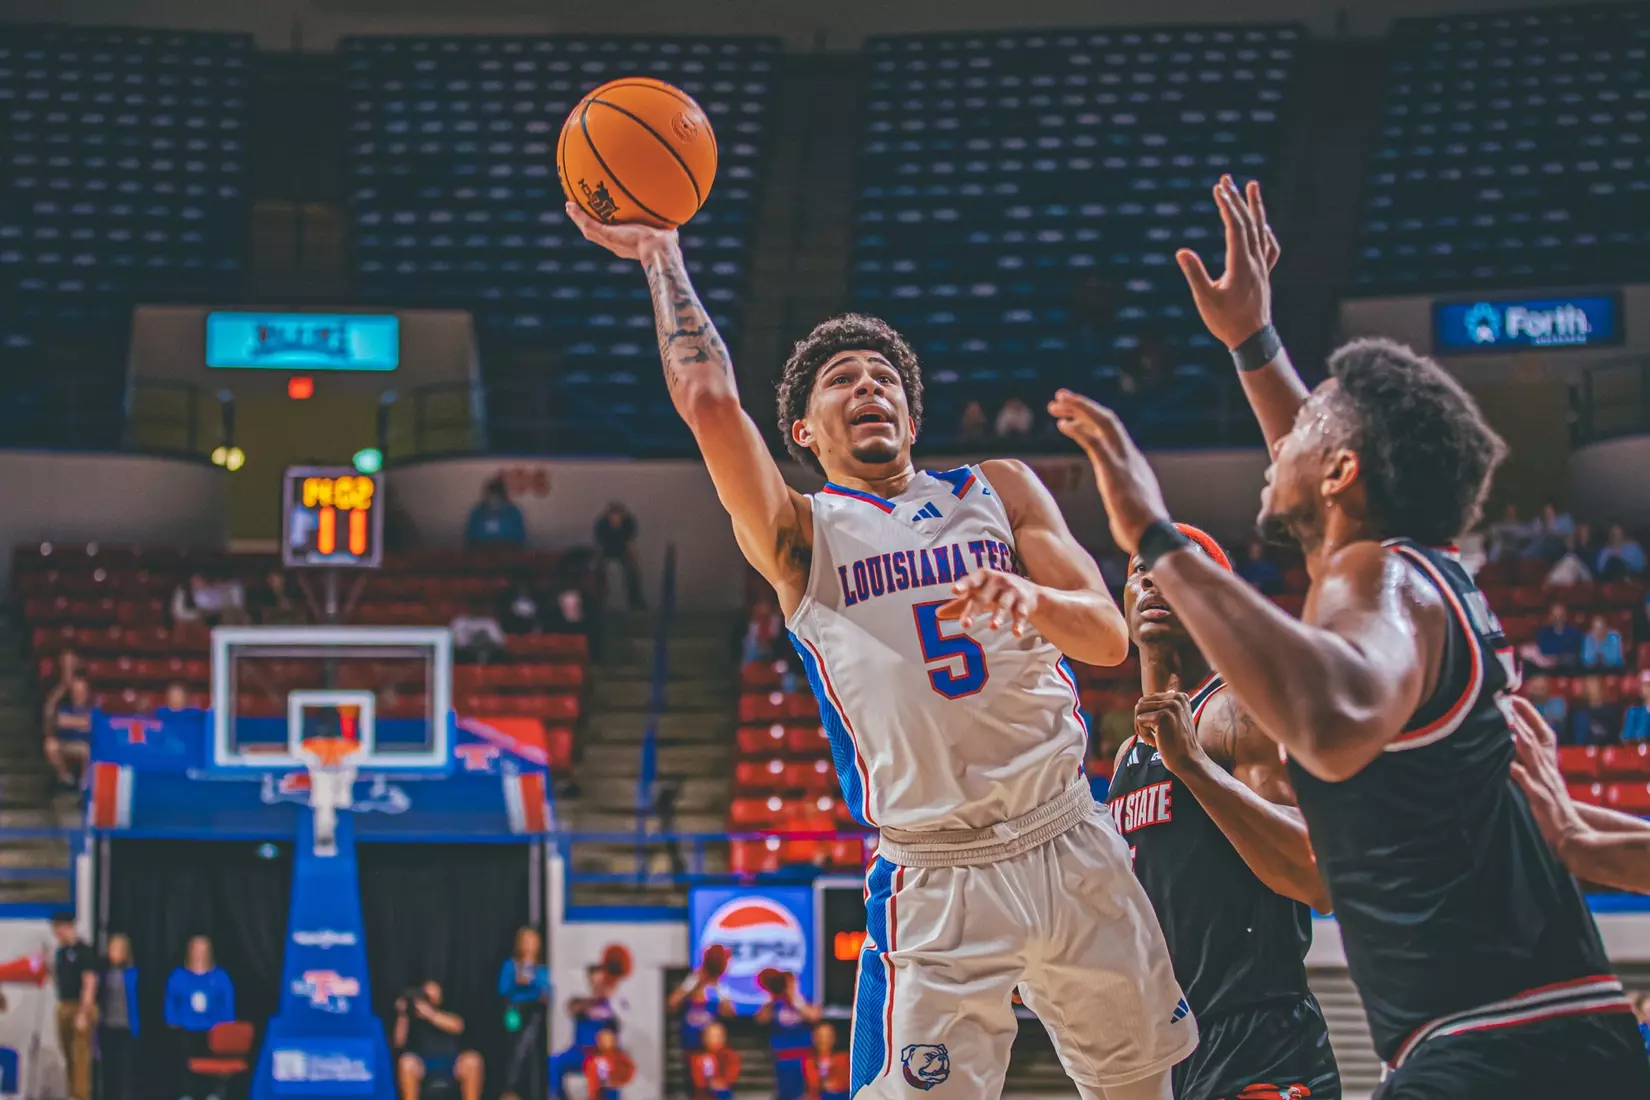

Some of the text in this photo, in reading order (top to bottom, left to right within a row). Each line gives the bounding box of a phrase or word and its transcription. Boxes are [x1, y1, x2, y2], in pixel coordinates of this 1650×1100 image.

[318, 507, 367, 555] 11
[838, 540, 1020, 607] LOUISIANA TEC
[912, 599, 989, 700] 5
[1125, 780, 1173, 833] STATE
